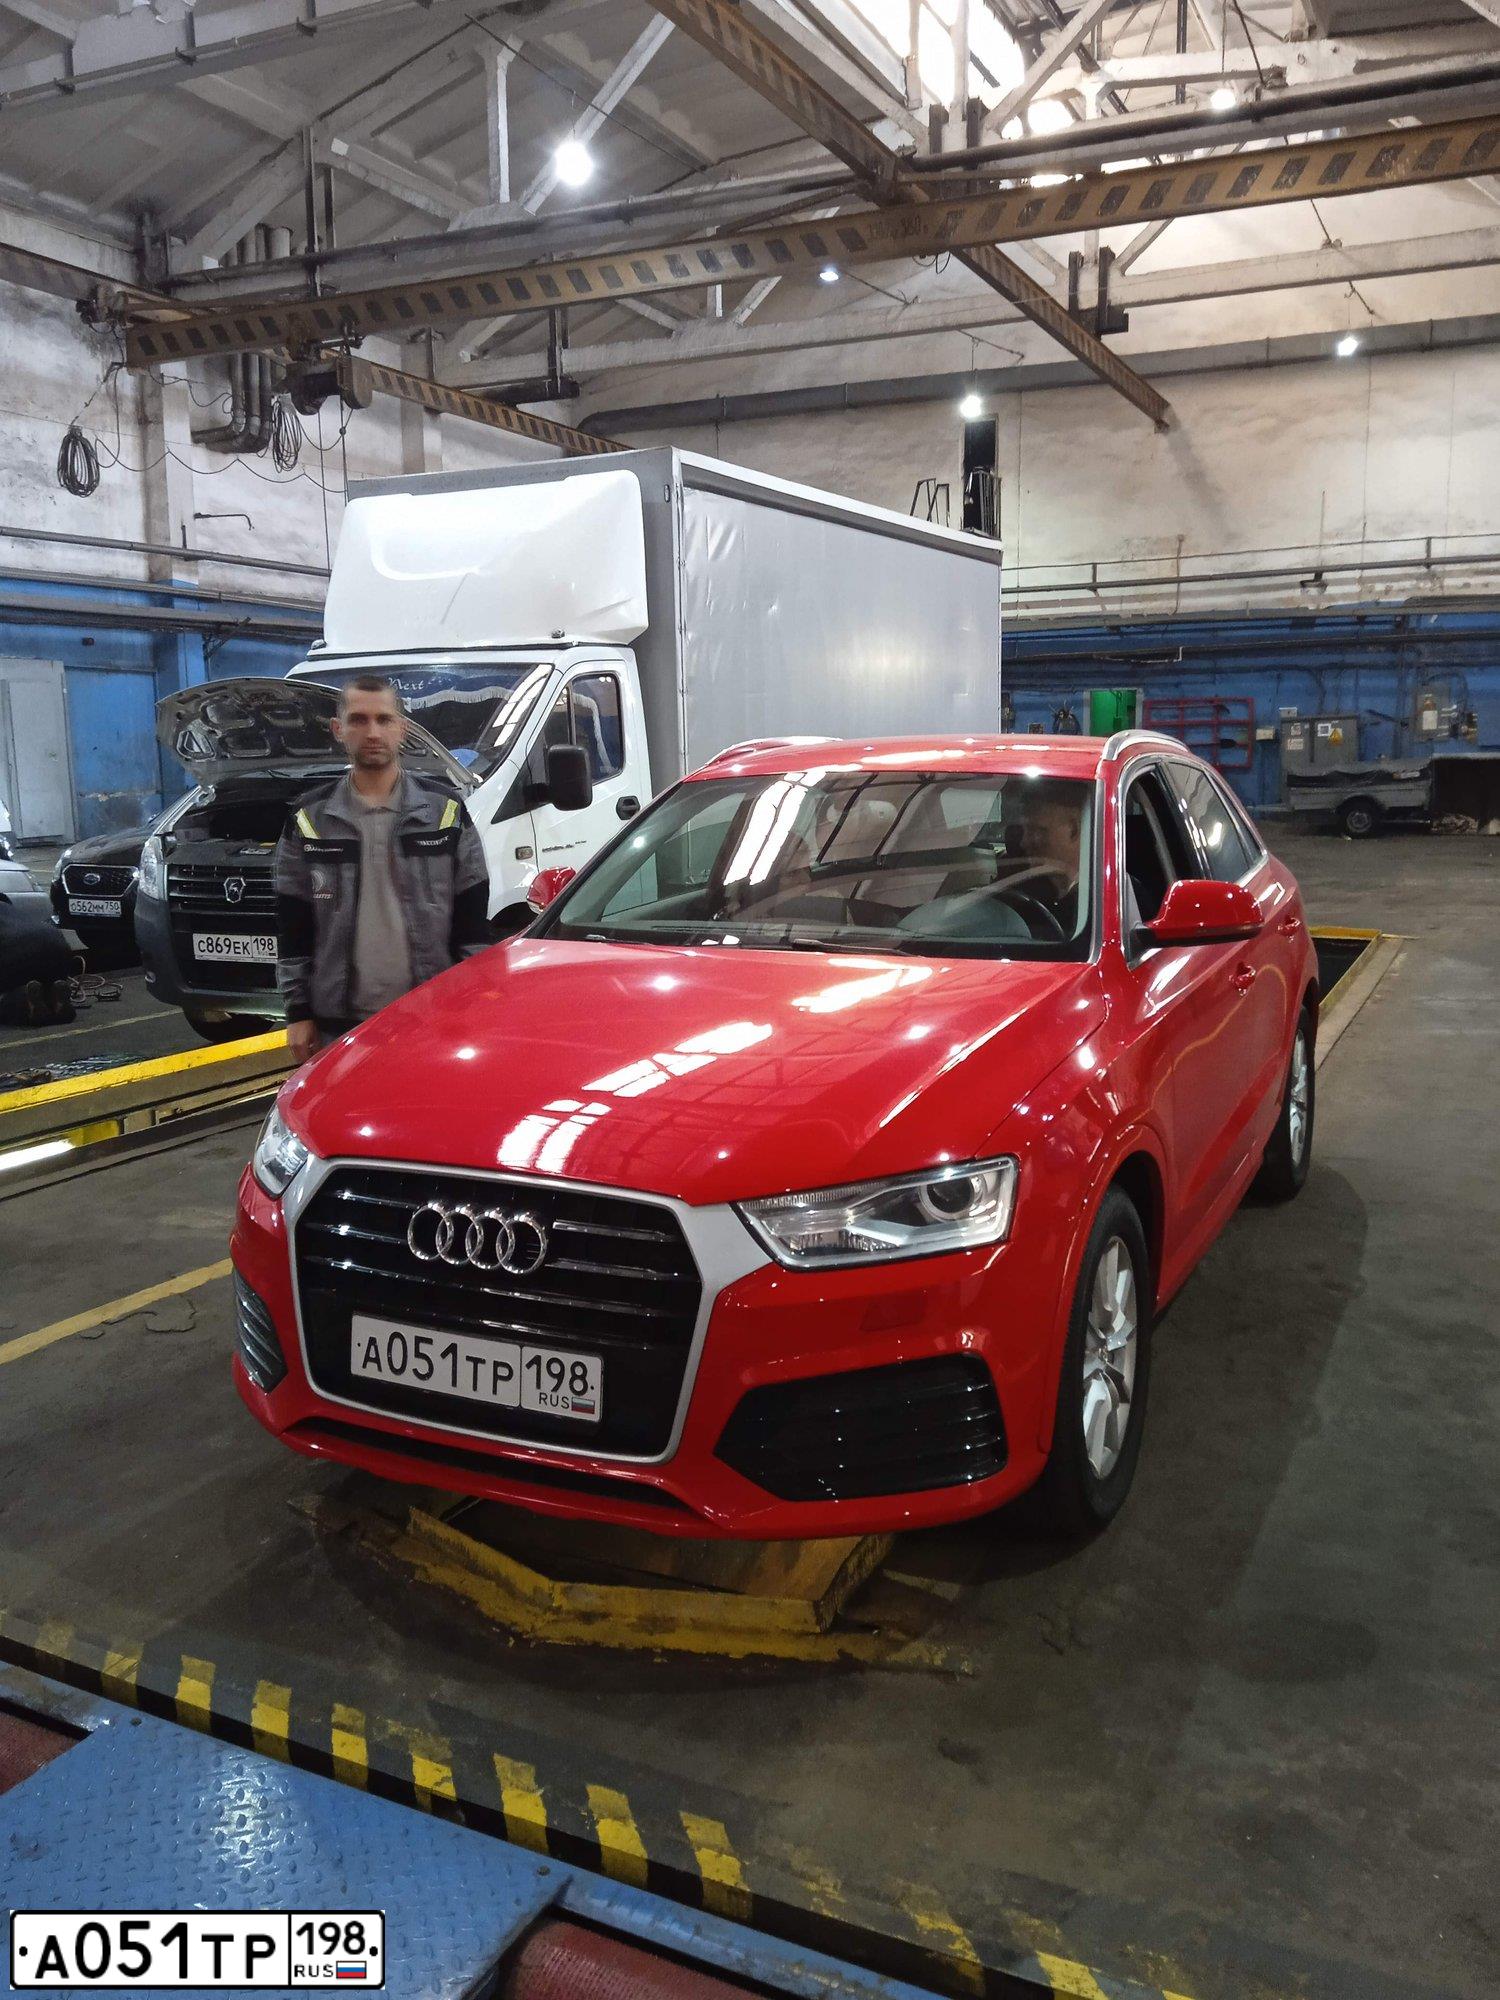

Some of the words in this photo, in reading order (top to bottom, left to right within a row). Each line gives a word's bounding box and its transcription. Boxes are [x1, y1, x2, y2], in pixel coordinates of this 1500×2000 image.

[388, 677, 425, 690] Next
[197, 936, 251, 955] С869ЕК
[253, 937, 274, 951] 198
[361, 1331, 514, 1396] А051ТР
[525, 1354, 589, 1397] 198
[538, 1392, 570, 1410] RUS
